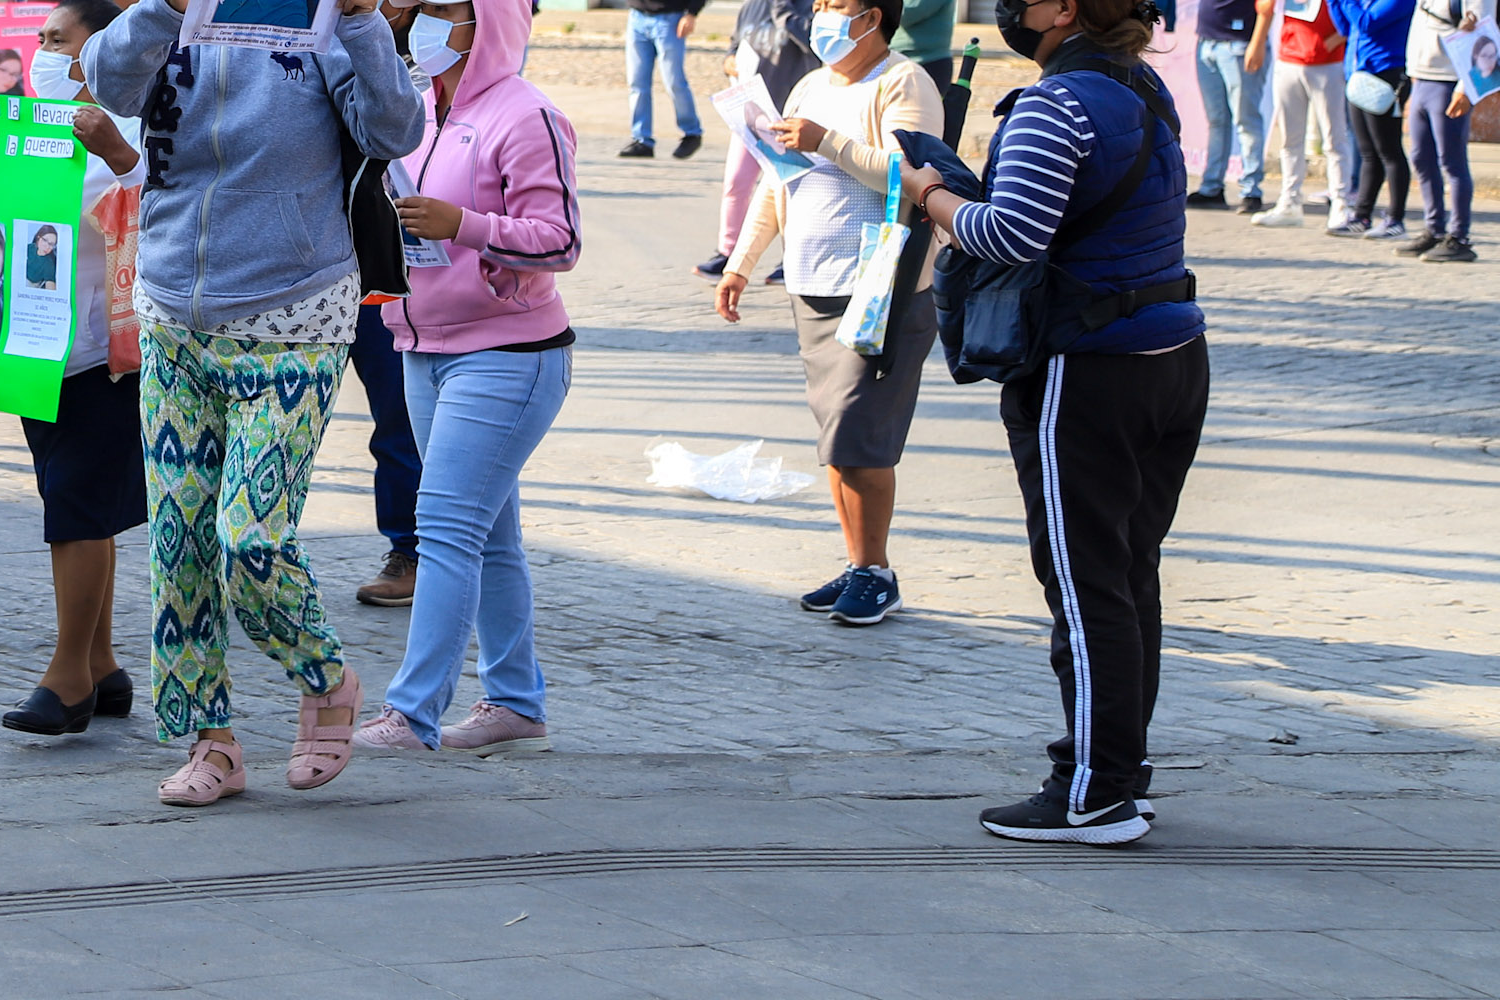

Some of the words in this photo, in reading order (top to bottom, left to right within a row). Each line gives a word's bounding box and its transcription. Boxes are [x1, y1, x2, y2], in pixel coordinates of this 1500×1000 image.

[8, 99, 19, 118] la
[33, 103, 73, 124] llevaro
[7, 134, 18, 155] la
